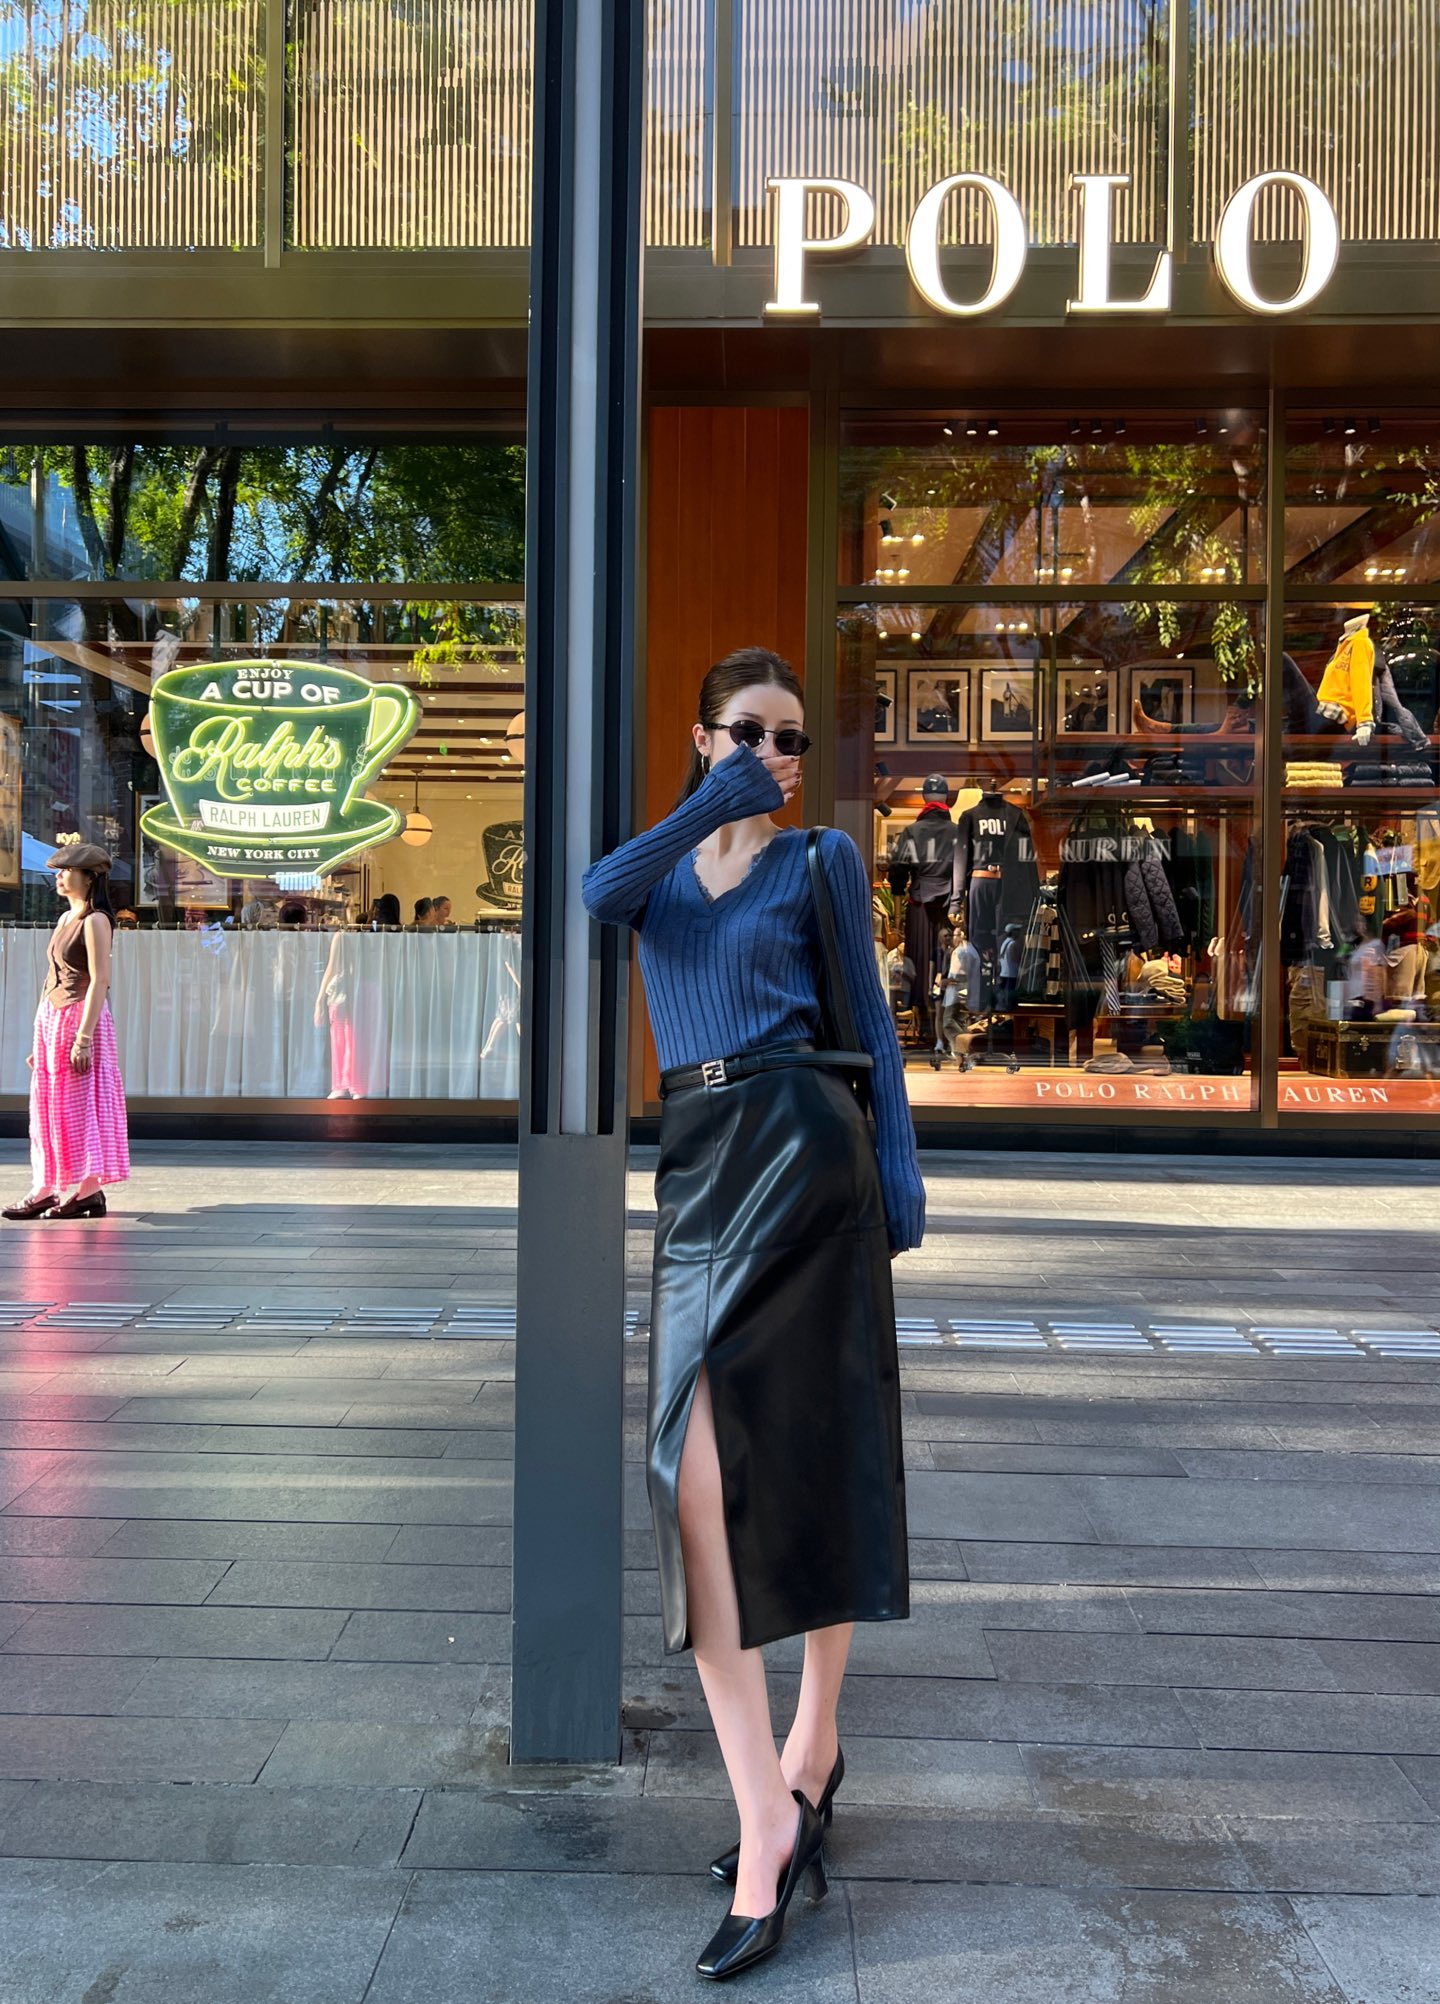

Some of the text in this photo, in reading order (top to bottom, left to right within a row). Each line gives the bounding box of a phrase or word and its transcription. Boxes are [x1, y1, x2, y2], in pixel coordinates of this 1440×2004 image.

[762, 170, 1341, 317] POLO
[236, 668, 294, 680] ENJOY
[199, 680, 341, 704] A CUP OF
[236, 778, 337, 793] COFFEE
[210, 806, 321, 827] RALPH LAUREN
[978, 818, 1007, 836] POL
[207, 845, 321, 860] NEW YORK CITY
[1035, 1082, 1389, 1103] POLO RALPH AUREN
